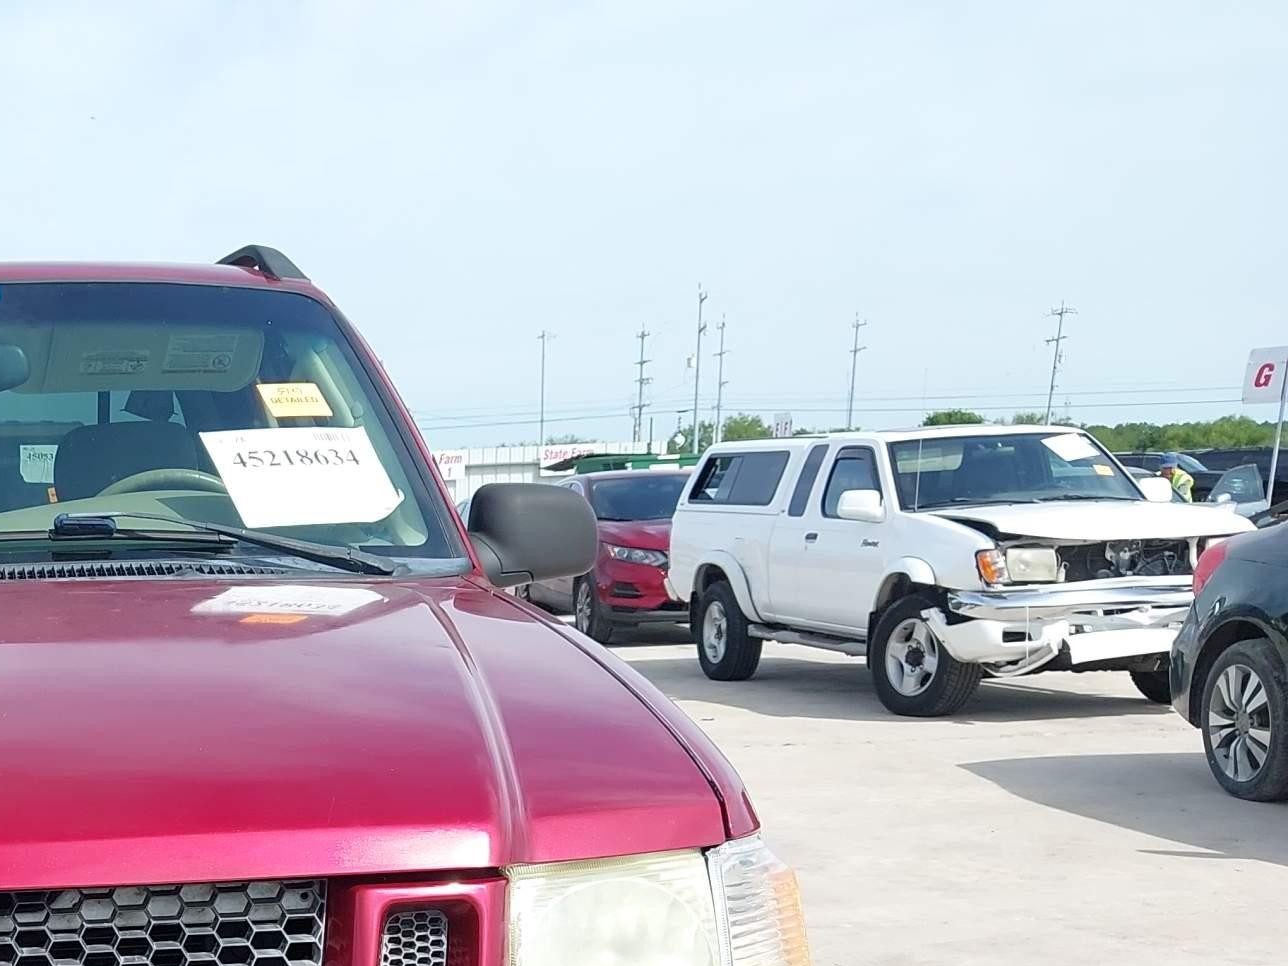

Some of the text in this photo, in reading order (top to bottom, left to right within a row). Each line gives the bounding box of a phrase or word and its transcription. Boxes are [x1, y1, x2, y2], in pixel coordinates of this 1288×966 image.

[1254, 363, 1275, 388] G
[233, 449, 360, 468] 45218634
[439, 453, 463, 465] Farm
[543, 449, 569, 460] State
